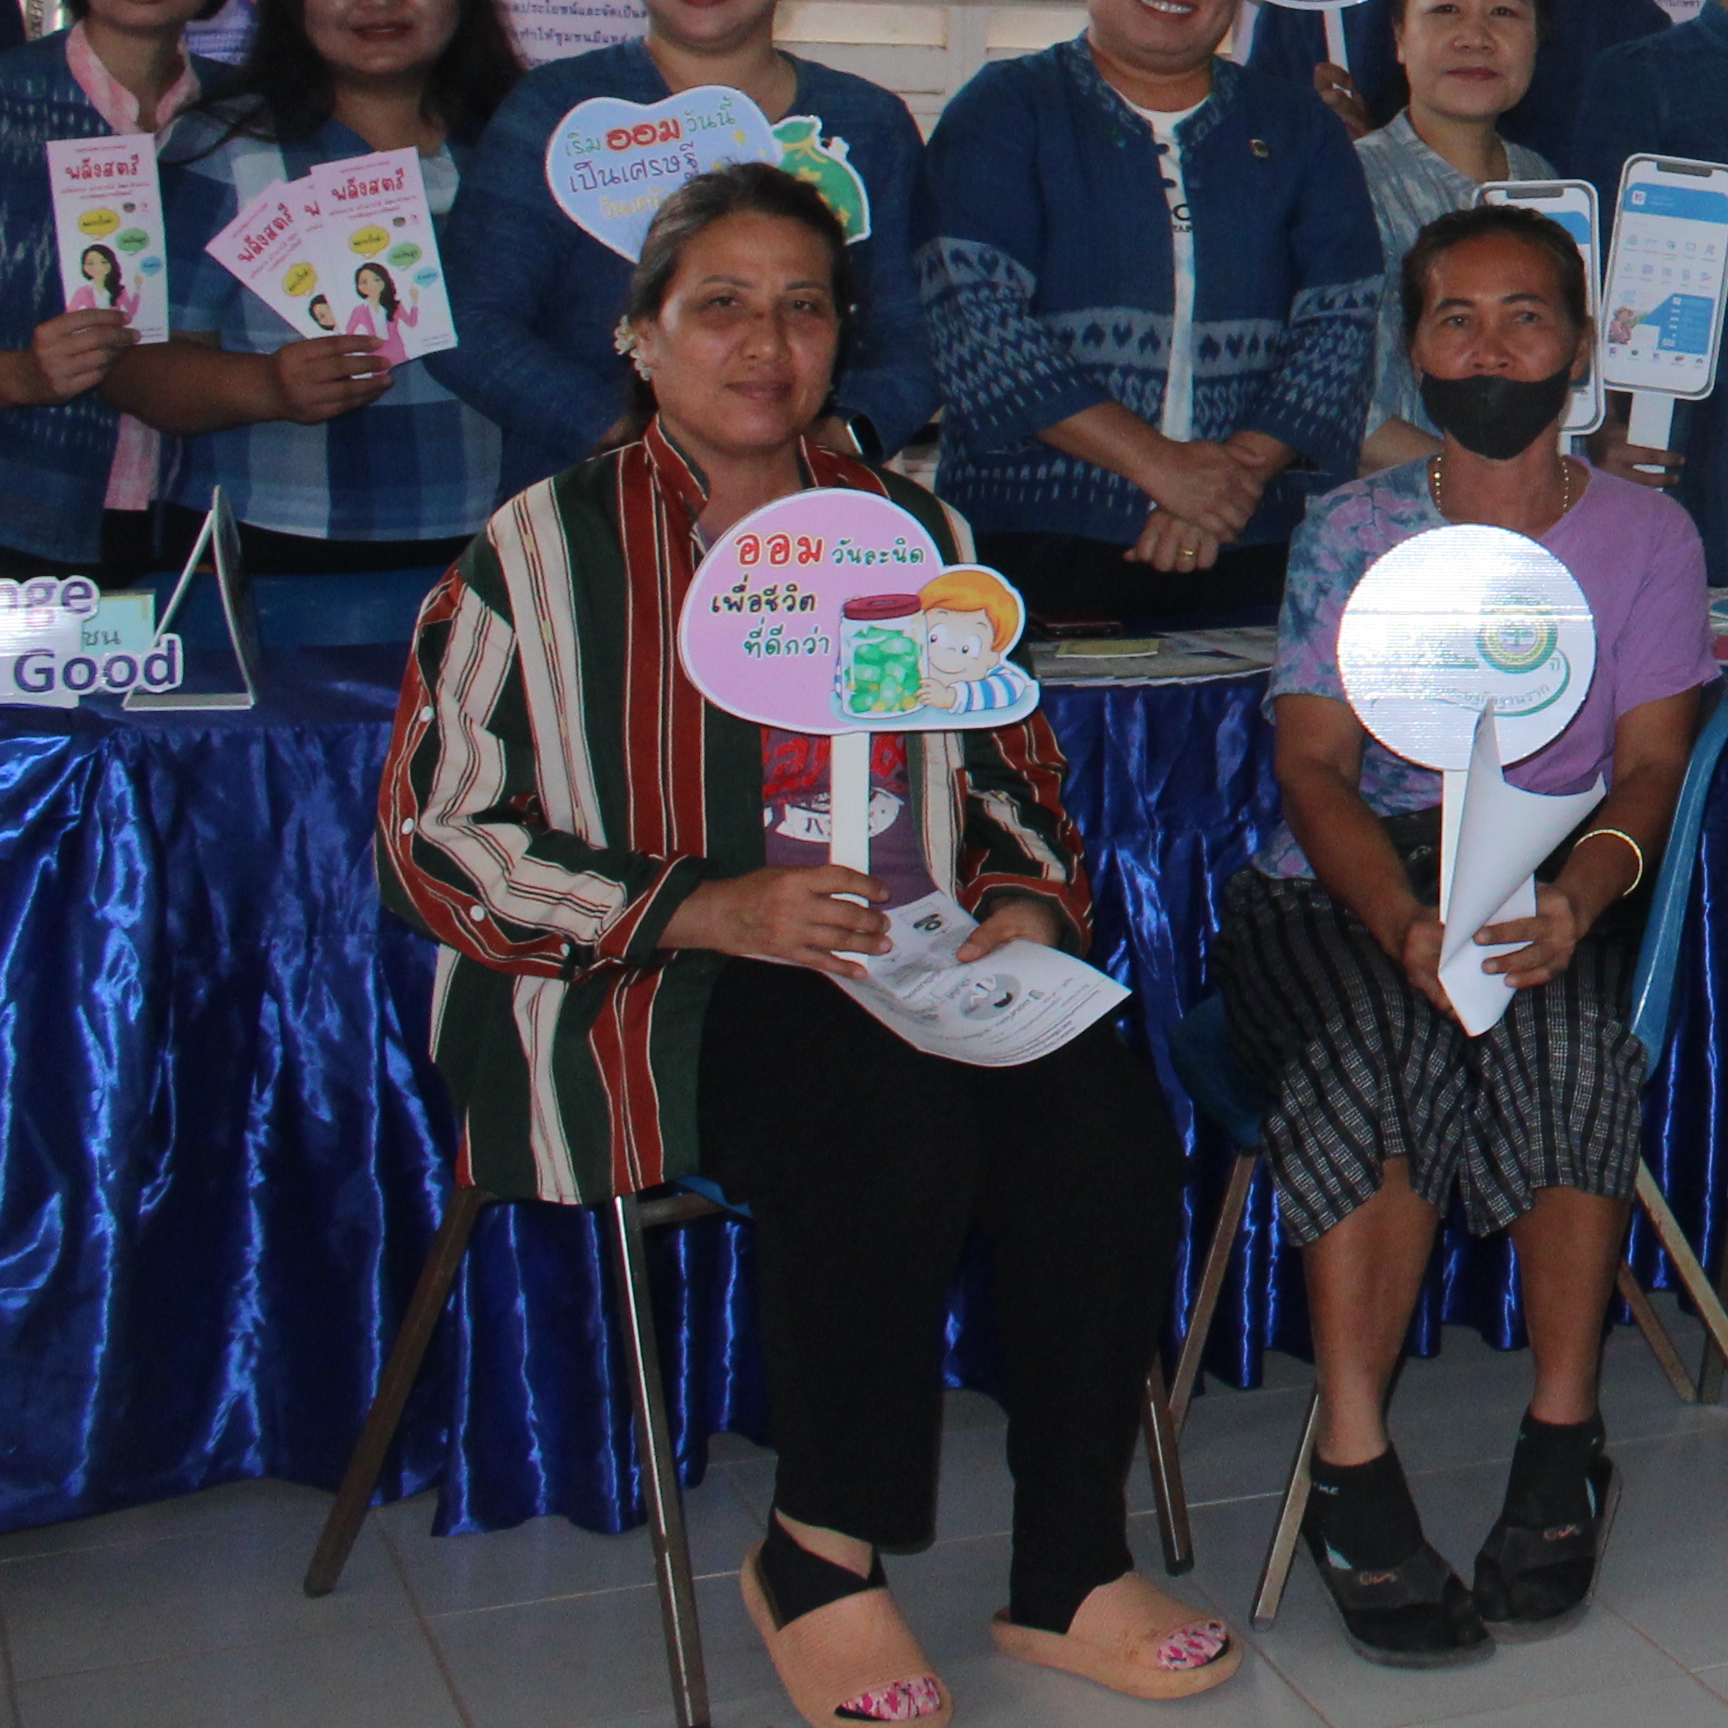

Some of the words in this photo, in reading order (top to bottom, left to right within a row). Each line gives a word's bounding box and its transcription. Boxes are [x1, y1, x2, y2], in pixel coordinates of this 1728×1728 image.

[565, 126, 601, 157] เริ่ม
[606, 117, 682, 151] ออม
[688, 96, 737, 133] วันนี้
[66, 153, 140, 181] พลังสตรี
[332, 167, 406, 201] พลังสตรี
[735, 533, 824, 566] ออม
[831, 537, 926, 566] วันละนิด
[711, 573, 816, 614] เพื่อชีวิต
[742, 618, 831, 659] ที่ดีกว่า
[14, 638, 177, 693] Good
